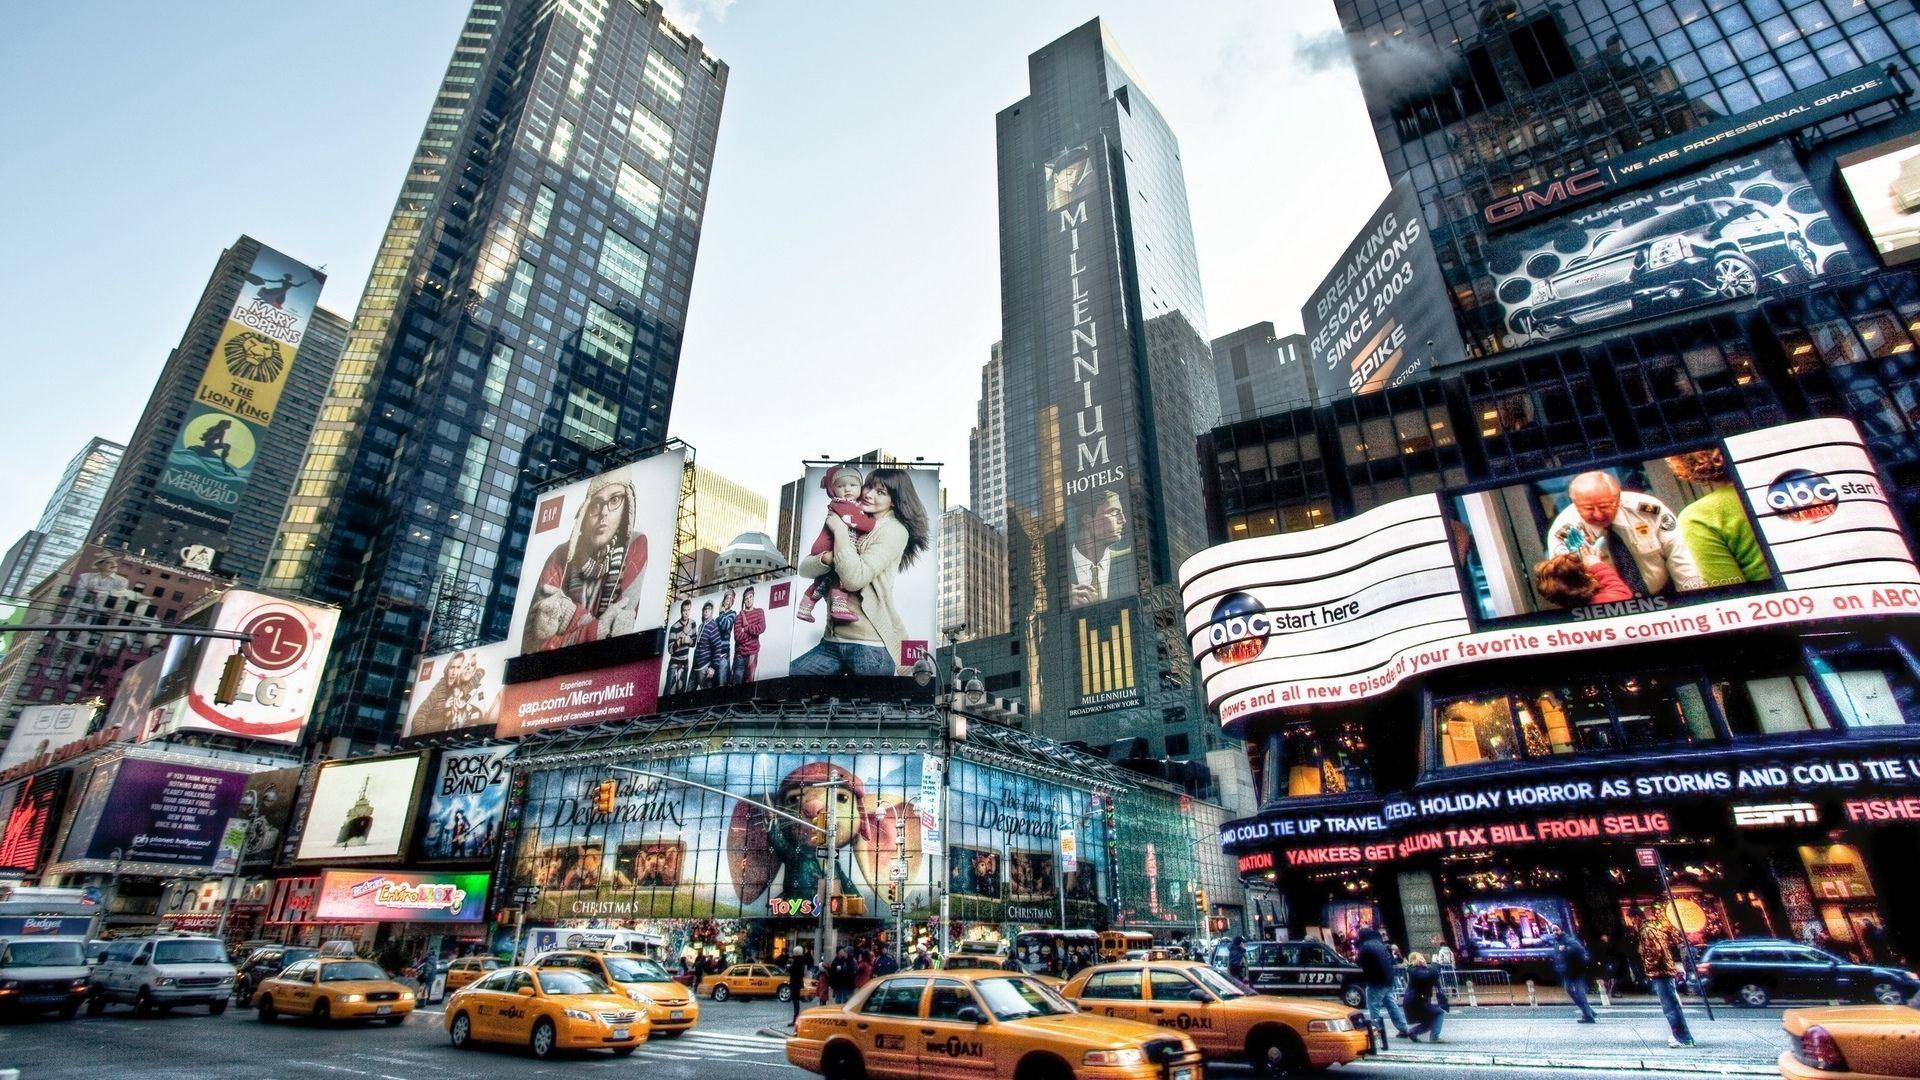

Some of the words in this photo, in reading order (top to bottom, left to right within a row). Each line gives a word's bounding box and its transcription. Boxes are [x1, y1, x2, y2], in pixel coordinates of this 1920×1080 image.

[1619, 163, 1645, 174] WE
[1648, 149, 1680, 168] ARE
[1683, 105, 1812, 153] PROFESSIONAL
[1485, 168, 1606, 225] GMC
[1571, 193, 1656, 225] YUKON
[1658, 159, 1762, 199] DENALI
[1317, 212, 1398, 321] BREAKING
[1310, 217, 1421, 359] RESOLUTIONS
[234, 306, 301, 343] POPPINS
[249, 301, 298, 328] MARY
[1326, 308, 1372, 371] SINCE
[1373, 261, 1414, 317] 2003
[1060, 202, 1111, 473] MILLENNIUM
[1348, 324, 1407, 394] SPIKE
[1392, 358, 1421, 388] ACTION
[199, 385, 234, 408] LION
[234, 399, 270, 420] KING
[230, 382, 254, 398] THE
[162, 469, 239, 504] MERMAID
[184, 471, 202, 482] THE
[201, 476, 230, 490] LITTLE
[1066, 465, 1124, 496] HOTELS
[1766, 482, 1839, 510] abc
[1841, 482, 1878, 494] start
[541, 505, 558, 524] GAP
[773, 590, 786, 601] GAP
[1682, 576, 1742, 590] abc.com
[1571, 596, 1668, 621] SIEMENS
[1210, 610, 1270, 646] abc
[1276, 610, 1316, 630] start
[1322, 601, 1360, 624] here
[1250, 690, 1275, 708] and
[1282, 686, 1300, 701] all
[1307, 687, 1341, 698] new
[1396, 659, 1406, 676] of
[1410, 646, 1450, 672] your
[1457, 634, 1539, 658] favorite
[1547, 628, 1616, 646] shows
[1625, 614, 1711, 639] coming
[1718, 604, 1741, 625] in
[1748, 596, 1815, 620] 2009
[1833, 596, 1864, 609] on
[560, 680, 592, 690] Experience
[1082, 688, 1137, 705] MILLENNIUM
[518, 683, 634, 717] gap.com/MerryMixIt
[1069, 706, 1103, 717] BROADWAY
[1106, 702, 1121, 711] NEW
[1121, 700, 1140, 709] YORK
[526, 718, 549, 726] surprise
[570, 711, 594, 719] carolers
[595, 708, 607, 716] and
[442, 776, 488, 796] BAND
[488, 760, 504, 785] 2
[447, 753, 492, 778] ROCK
[615, 776, 644, 797] Tale
[648, 774, 665, 802] of
[1000, 788, 1020, 810] The
[1022, 792, 1043, 813] Tale
[1223, 829, 1235, 843] AND
[1238, 824, 1268, 840] COLD
[1272, 822, 1295, 836] TIE
[1300, 820, 1320, 834] UP
[1325, 816, 1387, 831] TRAVEL
[1420, 792, 1500, 814] HOLIDAY
[1508, 783, 1594, 806] HORROR
[1600, 780, 1631, 798] AS
[1637, 772, 1731, 794] STORMS
[1738, 768, 1787, 787] AND
[1794, 763, 1859, 784] COLD
[1862, 761, 1906, 778] TIE
[981, 799, 1058, 846] Despereau
[1733, 802, 1818, 824] ESPN
[175, 838, 211, 846] hollywood
[1287, 847, 1361, 864] YANKEES
[1364, 845, 1394, 859] GET
[1445, 828, 1485, 846] TAX
[1492, 825, 1535, 844] BILL
[1538, 820, 1598, 840] FROM
[1604, 813, 1670, 834] SELIG
[572, 901, 639, 916] CHRISTMAS
[1008, 906, 1052, 918] CHRISTMAS
[24, 919, 62, 929] Budget
[1298, 974, 1333, 983] NYPD
[1177, 1013, 1211, 1029] TAXI
[927, 1042, 946, 1052] NYC
[947, 1036, 982, 1057] TAXI
